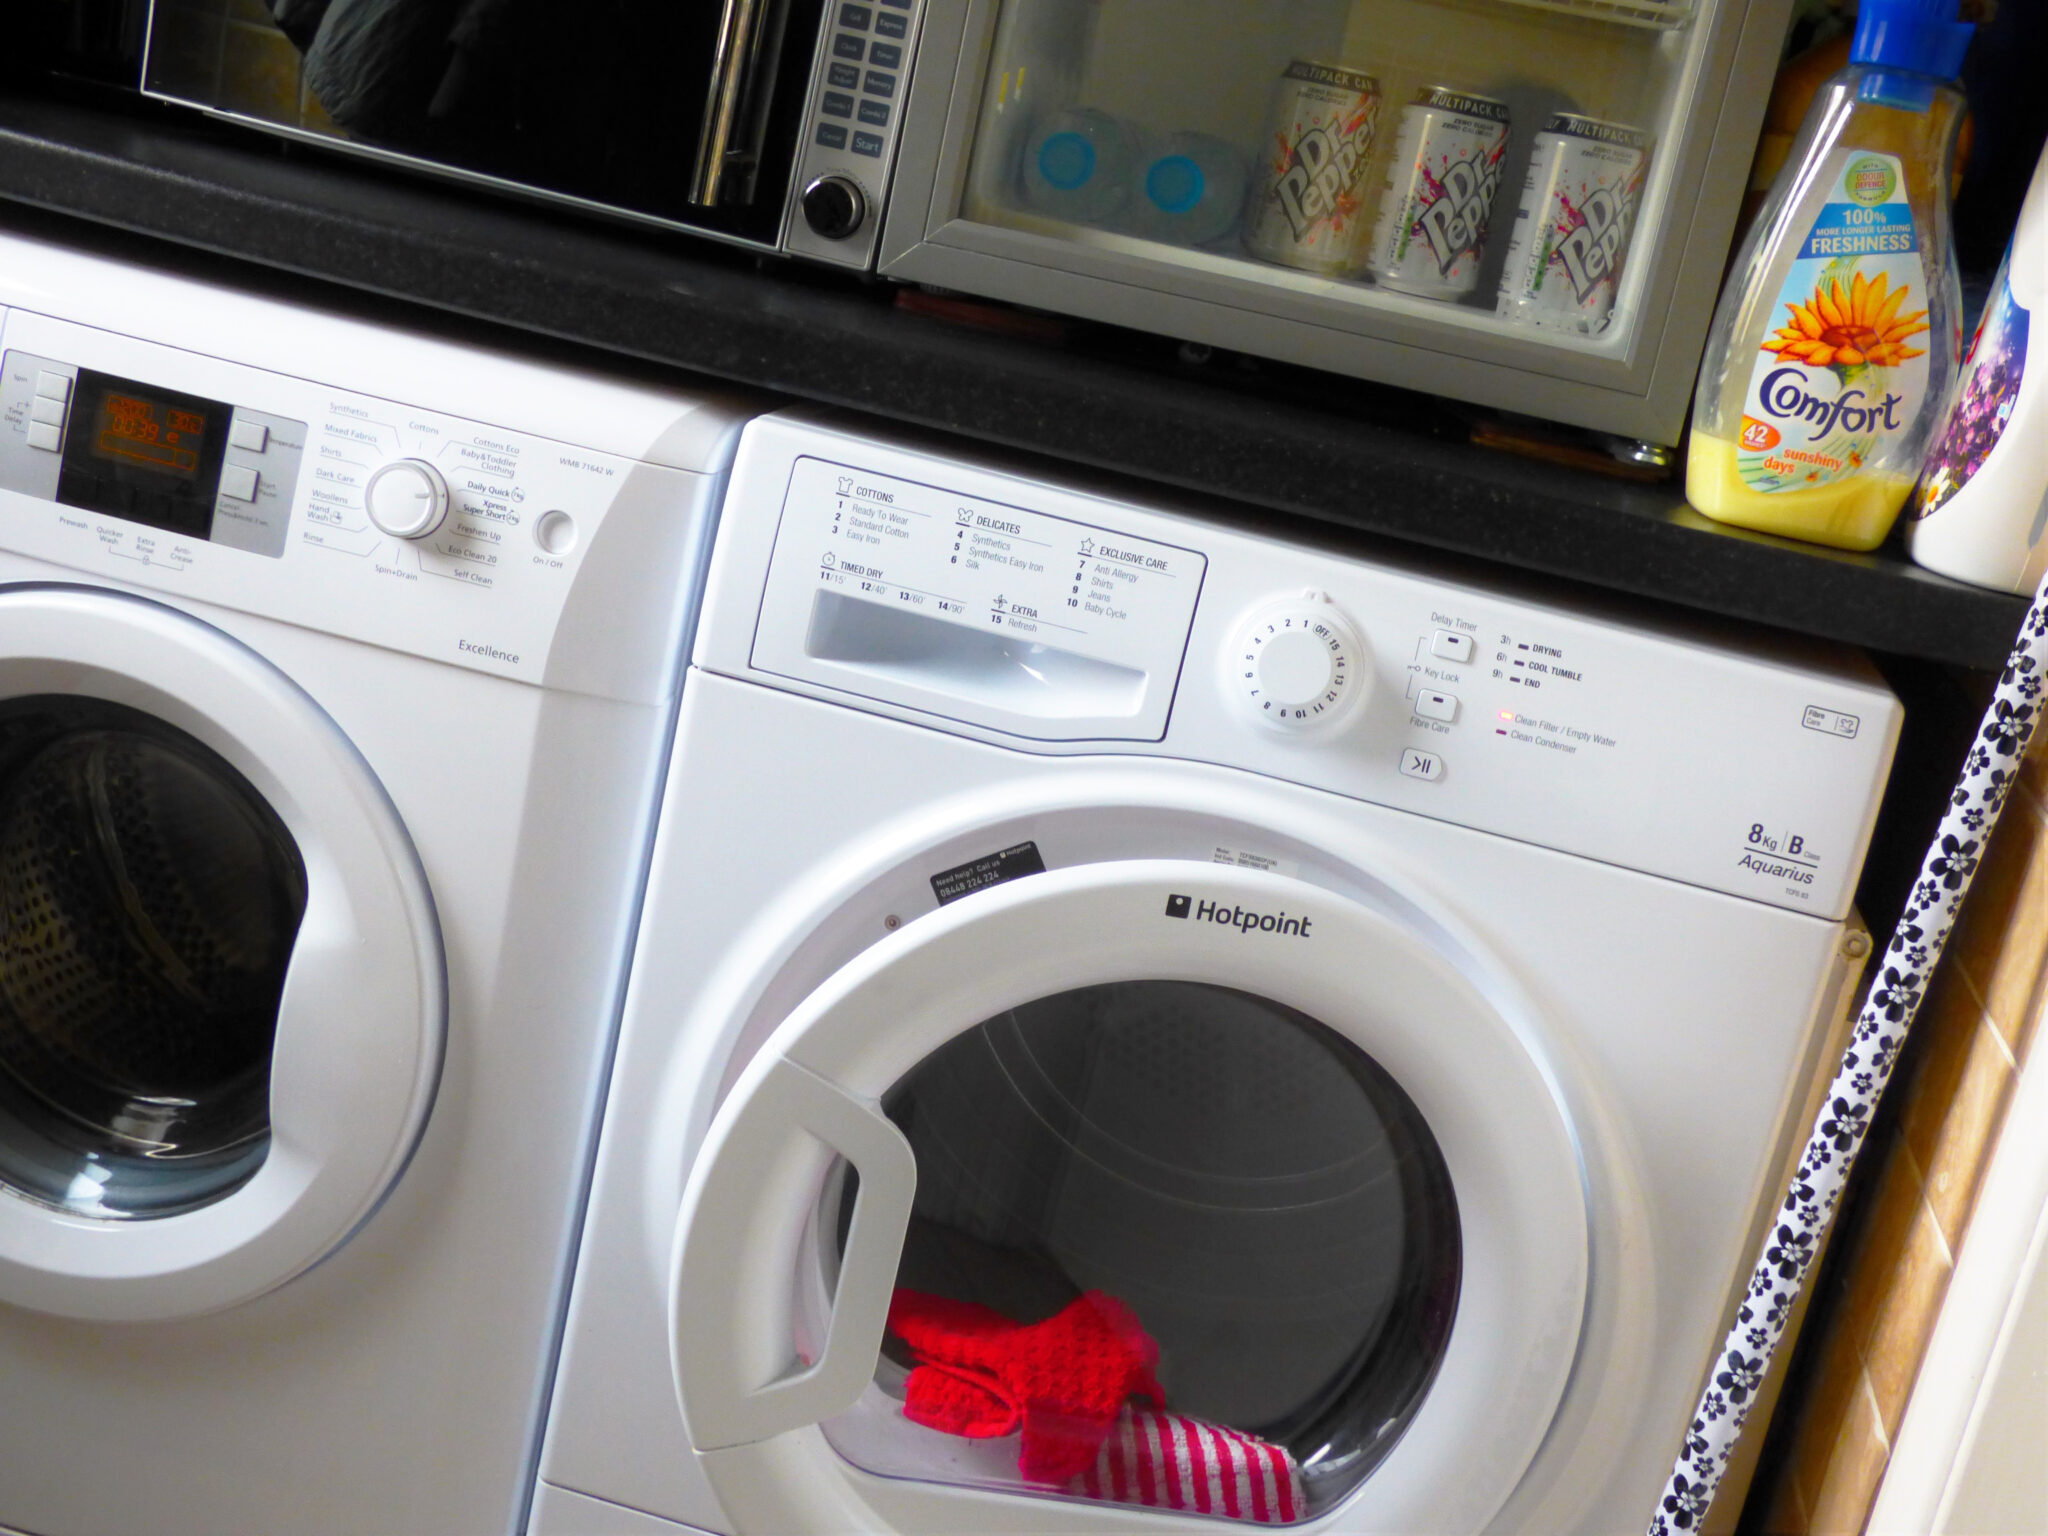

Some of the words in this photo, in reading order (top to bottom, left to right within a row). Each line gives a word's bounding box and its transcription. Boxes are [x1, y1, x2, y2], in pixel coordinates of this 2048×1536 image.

[1430, 93, 1492, 117] MULTIPACK
[1567, 119, 1631, 143] MULTIPACK
[856, 137, 879, 153] Start
[1419, 154, 1506, 274] Peppe
[1843, 208, 1887, 225] 100%
[1816, 228, 1841, 236] MORE
[1842, 225, 1875, 235] LONGER
[1877, 223, 1911, 233] LASTING
[1557, 200, 1634, 302] Pepp
[1811, 233, 1912, 254] FRESHNESS
[330, 402, 369, 418] Synthetics
[1759, 367, 1902, 441] Comfort
[325, 424, 349, 436] Mixed
[350, 429, 377, 443] Fabrics
[409, 421, 439, 435] Cottons
[1744, 424, 1769, 443] 42
[320, 446, 342, 457] Shirts
[473, 436, 504, 451] Cottons
[506, 444, 520, 454] Eco
[461, 448, 517, 467] Baby&Toddler
[560, 457, 579, 468] WMB
[1763, 456, 1795, 475] days
[1783, 448, 1844, 473] sunshiny
[316, 467, 334, 479] Dark
[336, 473, 355, 483] Care
[481, 462, 515, 477] Clothing
[312, 489, 348, 504] Woollens
[467, 480, 486, 492] Daily
[488, 486, 510, 498] Quick
[856, 486, 894, 503] COTTONS
[308, 503, 330, 514] Hand
[463, 504, 484, 516] Super
[486, 508, 506, 520] Short
[483, 499, 507, 511] Xpress
[852, 503, 876, 518] Ready
[877, 510, 887, 520] To
[889, 513, 909, 525] Wear
[59, 516, 88, 529] Prewash
[307, 510, 329, 521] Wash
[976, 515, 1021, 534] DELICATES
[96, 526, 123, 538] Quicker
[457, 523, 488, 538] Freshen
[490, 531, 502, 541] Up
[835, 512, 841, 521] 2
[849, 516, 884, 533] Standard
[885, 524, 909, 539] Cotton
[100, 535, 119, 545] Wash
[137, 536, 155, 546] Extra
[303, 532, 324, 543] Rinse
[832, 525, 838, 534] 3
[846, 530, 864, 542] Easy
[866, 534, 880, 545] Iron
[957, 530, 963, 539] 4
[971, 533, 1011, 551] Synthetics
[448, 545, 462, 555] Eco
[463, 547, 485, 560] Clean
[487, 554, 497, 563] 20
[533, 556, 544, 565] On
[550, 560, 563, 569] Off
[951, 555, 957, 564] 6
[965, 559, 980, 570] Silk
[954, 542, 960, 551] 5
[969, 546, 1007, 564] Synthetics
[1009, 554, 1027, 570] Easy
[1029, 561, 1044, 573] Iron
[1099, 546, 1144, 565] EXCLUSIVE
[1146, 557, 1168, 571] CARE
[375, 564, 418, 582] Spin+Drain
[454, 568, 469, 579] Self
[471, 573, 493, 585] Clean
[840, 561, 864, 575] TIMED
[867, 568, 884, 579] DRY
[1080, 560, 1086, 569] 7
[1094, 564, 1110, 575] Anti
[1112, 568, 1139, 583] Allergy
[1075, 572, 1082, 581] 8
[1091, 576, 1114, 590] Shirts
[1072, 585, 1079, 594] 9
[1088, 590, 1111, 602] Jeans
[1011, 604, 1038, 618] EXTRA
[1067, 598, 1078, 607] 10
[1084, 601, 1104, 615] Baby
[1106, 607, 1127, 620] Cycle
[991, 614, 1002, 624] 15
[1008, 618, 1037, 632] Refresh
[1267, 625, 1275, 633] 3
[1285, 619, 1291, 627] 2
[1431, 612, 1453, 627] Delay
[1455, 618, 1478, 631] Timer
[1315, 624, 1330, 638] OFF
[1500, 635, 1511, 645] 3h
[458, 639, 519, 664] Excellence
[1329, 639, 1341, 651] 15
[1532, 644, 1563, 658] DRYING
[1336, 656, 1346, 668] 14
[1496, 652, 1507, 663] 6h
[1334, 674, 1345, 686] 13
[1424, 666, 1440, 680] Key
[1441, 671, 1459, 684] Lock
[1492, 668, 1503, 679] 9h
[1528, 661, 1548, 673] COOL
[1551, 666, 1583, 682] TUMBLE
[1524, 678, 1541, 689] END
[1326, 690, 1338, 702] 12
[1295, 709, 1307, 719] 10
[1410, 716, 1430, 729] Fibre
[1431, 722, 1450, 734] Care
[1514, 714, 1537, 727] Clean
[1539, 720, 1559, 733] Filter
[1566, 727, 1591, 743] Empty
[1593, 734, 1617, 747] Water
[1511, 729, 1533, 743] Clean
[1535, 736, 1577, 754] Condenser
[1748, 823, 1764, 844] 8
[1762, 835, 1778, 852] Kg
[1788, 835, 1804, 855] B
[936, 875, 954, 887] Need
[955, 868, 974, 880] help?
[976, 862, 990, 872] Call
[991, 860, 1001, 868] us
[1738, 854, 1815, 884] Aquarius
[940, 882, 966, 897] 08448
[967, 877, 982, 888] 224
[983, 871, 999, 882] 224
[1196, 899, 1312, 938] Hotpoint
